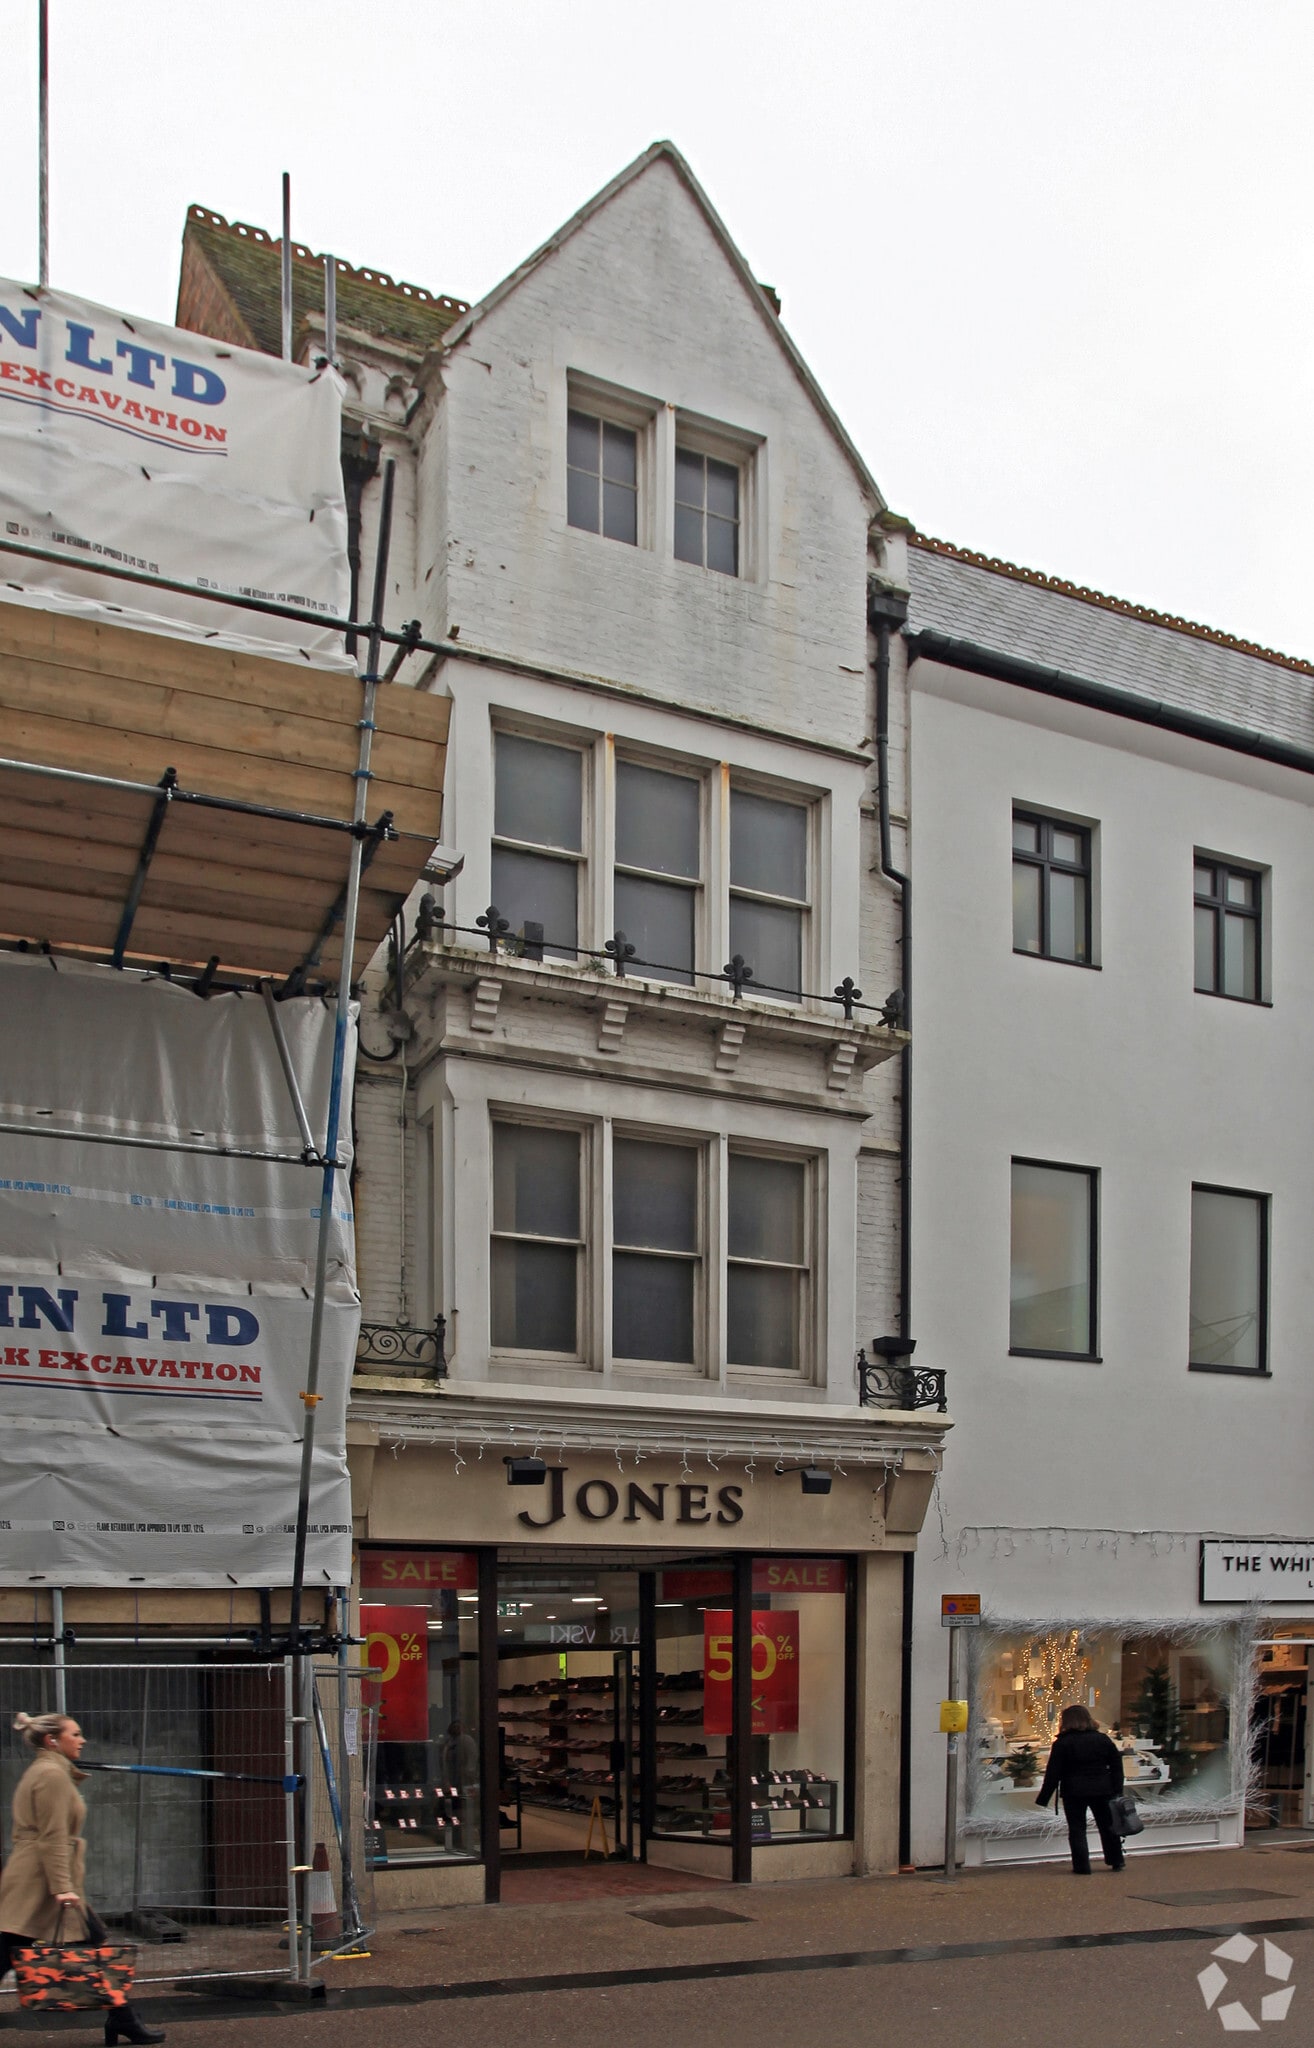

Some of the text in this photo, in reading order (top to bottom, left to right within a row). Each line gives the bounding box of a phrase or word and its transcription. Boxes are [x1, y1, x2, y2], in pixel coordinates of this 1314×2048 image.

[65, 320, 226, 405] LTD
[0, 361, 228, 442] EXCAVATION
[102, 1293, 260, 1346] LTD
[0, 1347, 262, 1383] K EXCAVATION
[518, 1467, 744, 1527] JONES
[382, 1559, 457, 1581] SALE
[768, 1566, 829, 1585] SALE
[1223, 1556, 1314, 1572] THE WHI
[401, 1652, 423, 1661] OFF
[776, 1652, 795, 1661] OFF
